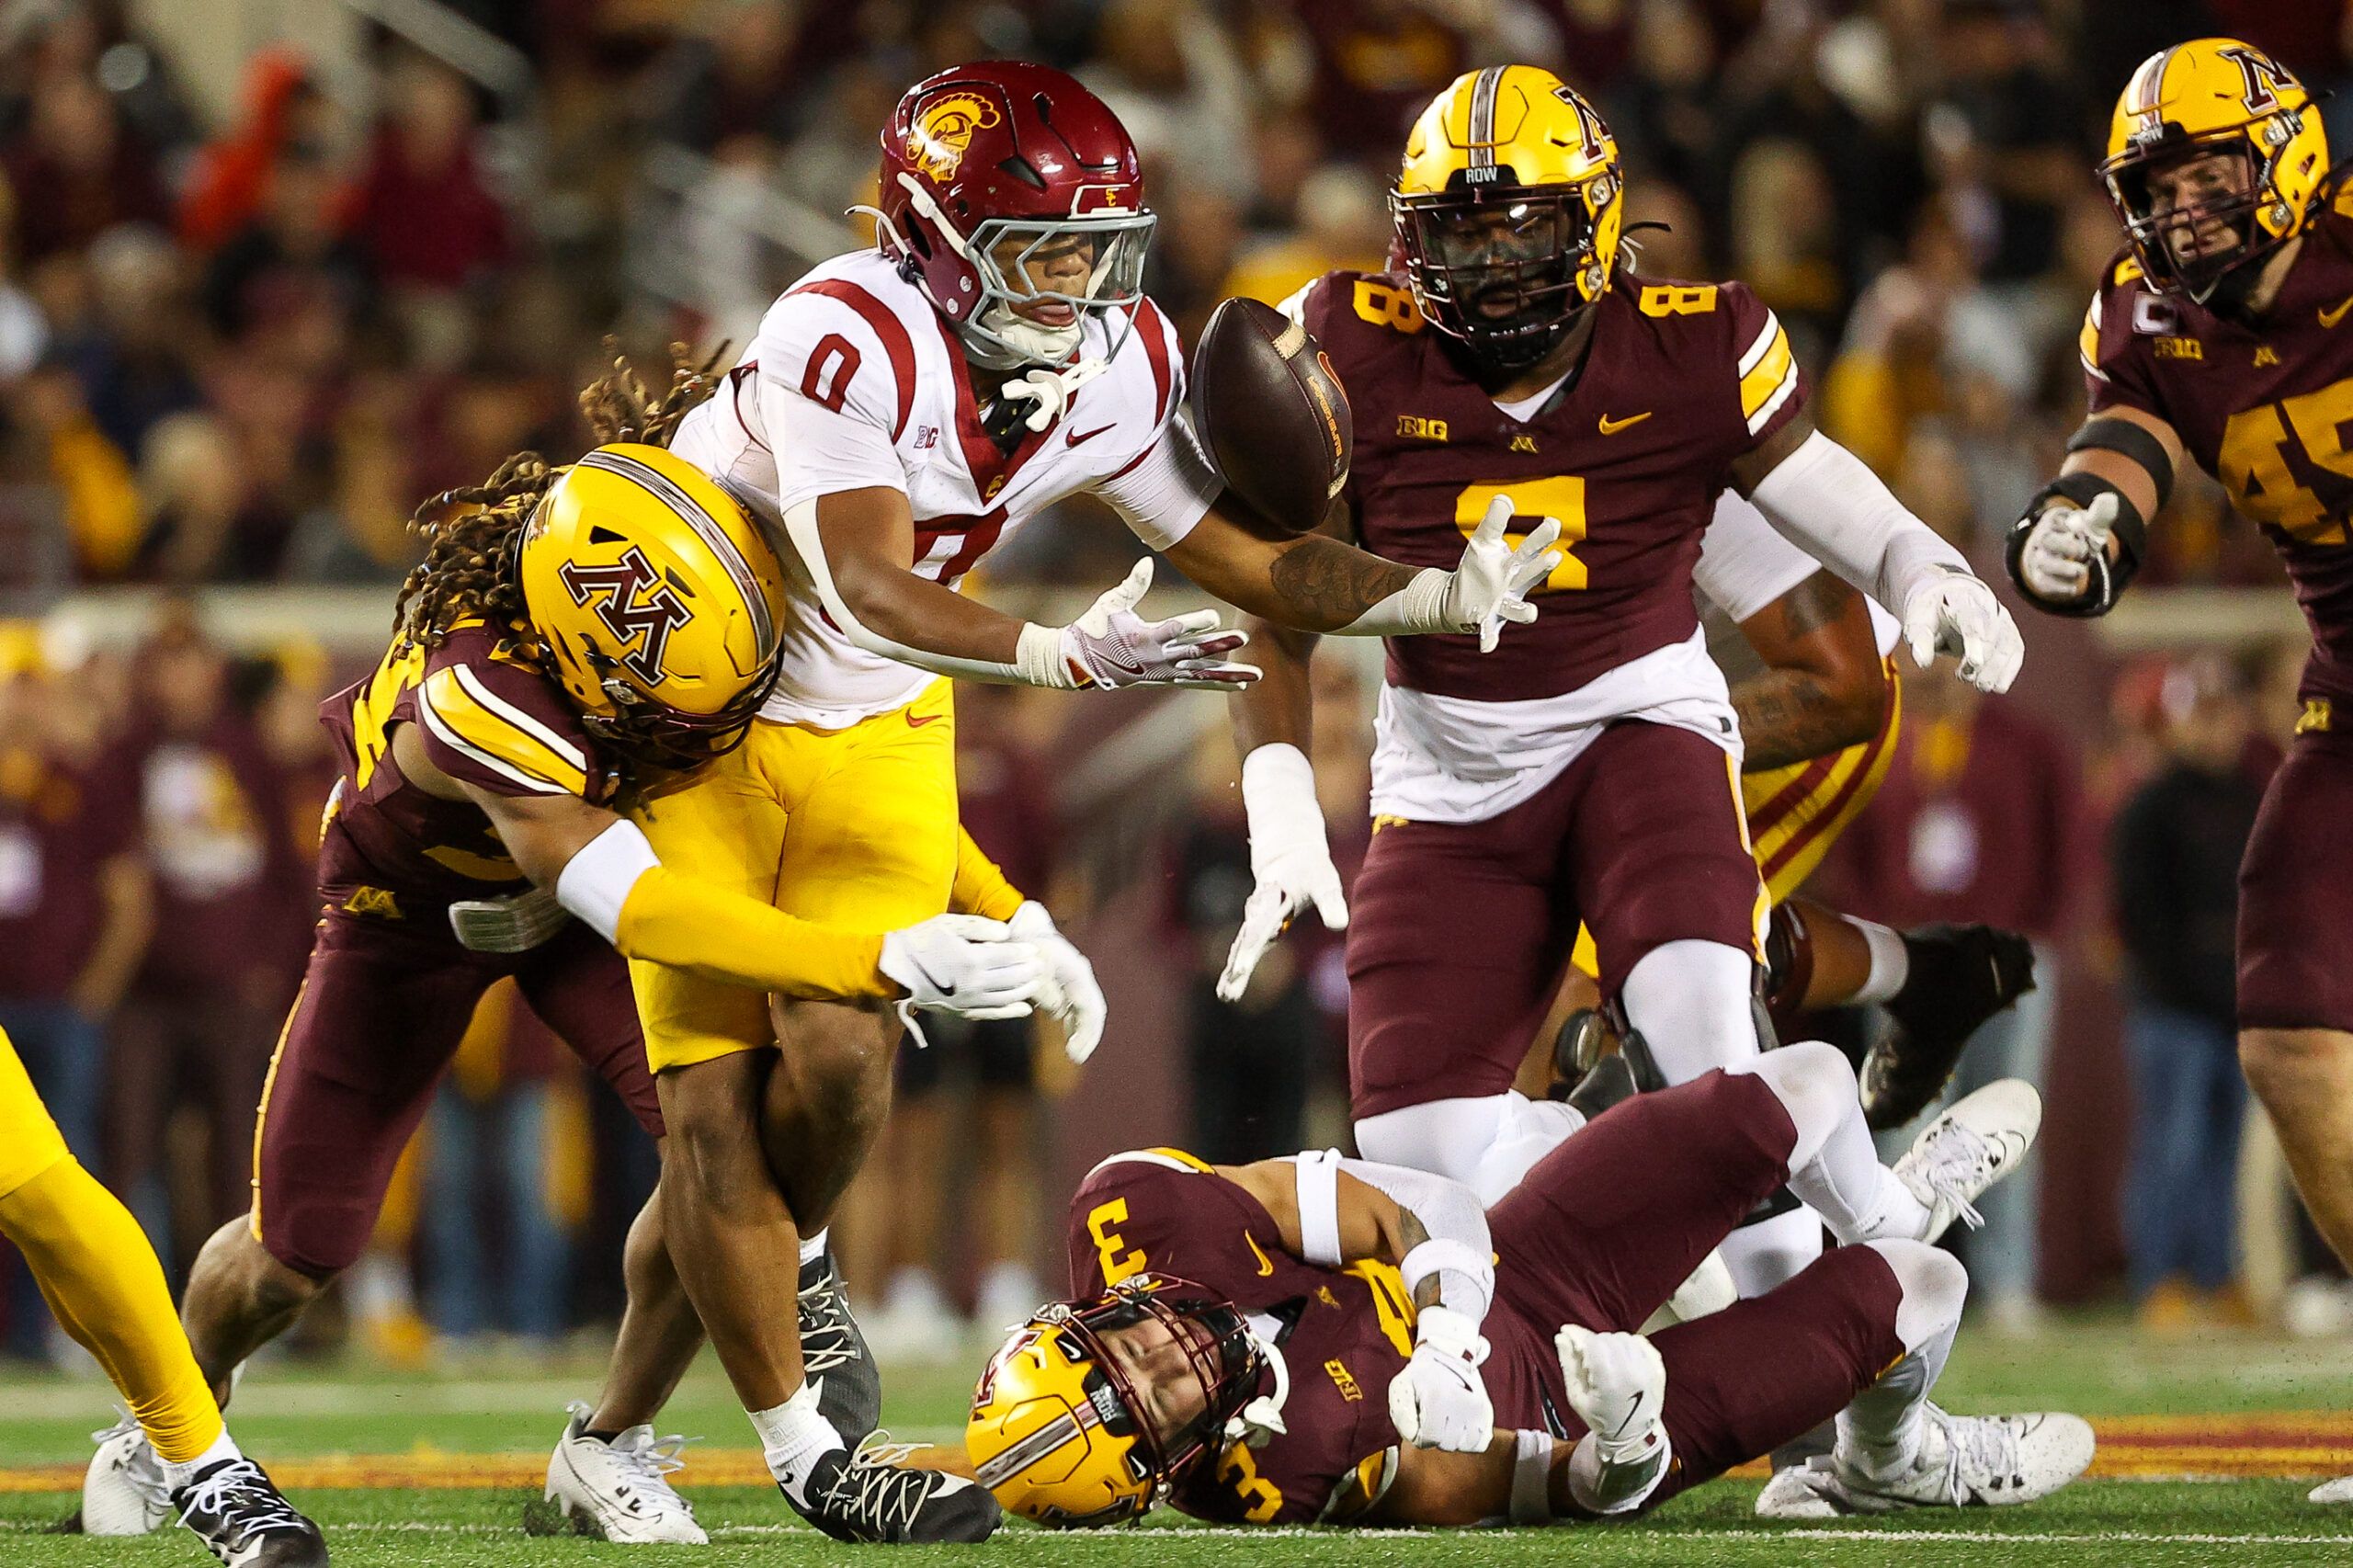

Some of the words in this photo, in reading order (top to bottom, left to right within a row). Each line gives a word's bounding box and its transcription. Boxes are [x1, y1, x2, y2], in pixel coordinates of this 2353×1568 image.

[1465, 165, 1497, 184] ROW
[1639, 284, 1719, 318] 8
[801, 334, 861, 415] 0
[557, 544, 695, 687] M
